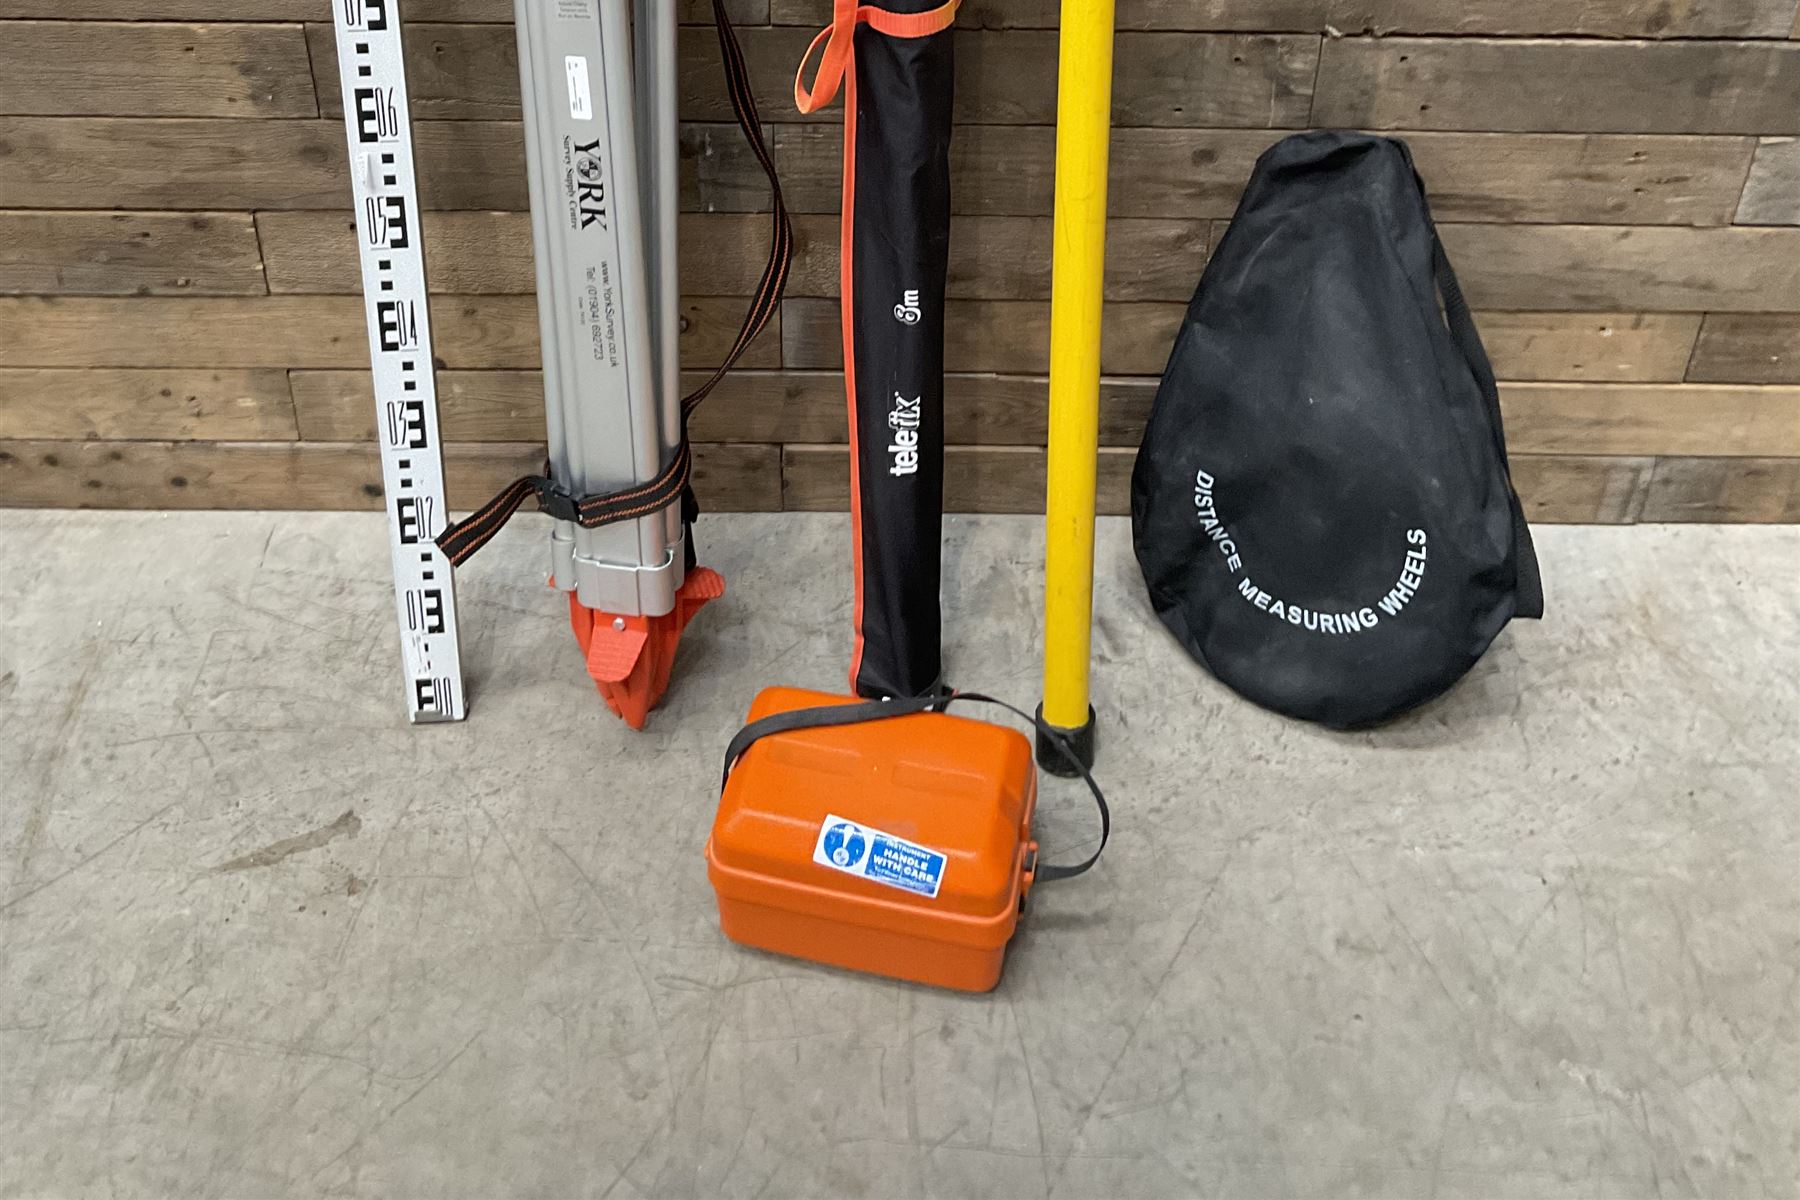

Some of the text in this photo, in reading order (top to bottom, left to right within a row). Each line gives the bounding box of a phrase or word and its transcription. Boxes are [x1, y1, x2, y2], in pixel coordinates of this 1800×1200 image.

[375, 87, 398, 137] 06
[562, 134, 578, 230] Survey Supply Centre
[574, 138, 607, 231] YORK
[366, 197, 387, 245] 05
[397, 300, 418, 346] 04
[586, 284, 600, 323] (01904)
[591, 324, 604, 361] 692723
[386, 401, 407, 446] 03
[887, 395, 921, 477] telefix
[415, 496, 434, 540] 02
[1194, 469, 1427, 634] DISTANCE MEASURING WHEELS
[405, 589, 425, 631] 01
[873, 853, 902, 873] WITH
[903, 864, 934, 883] CARE
[883, 847, 929, 871] HANDLE
